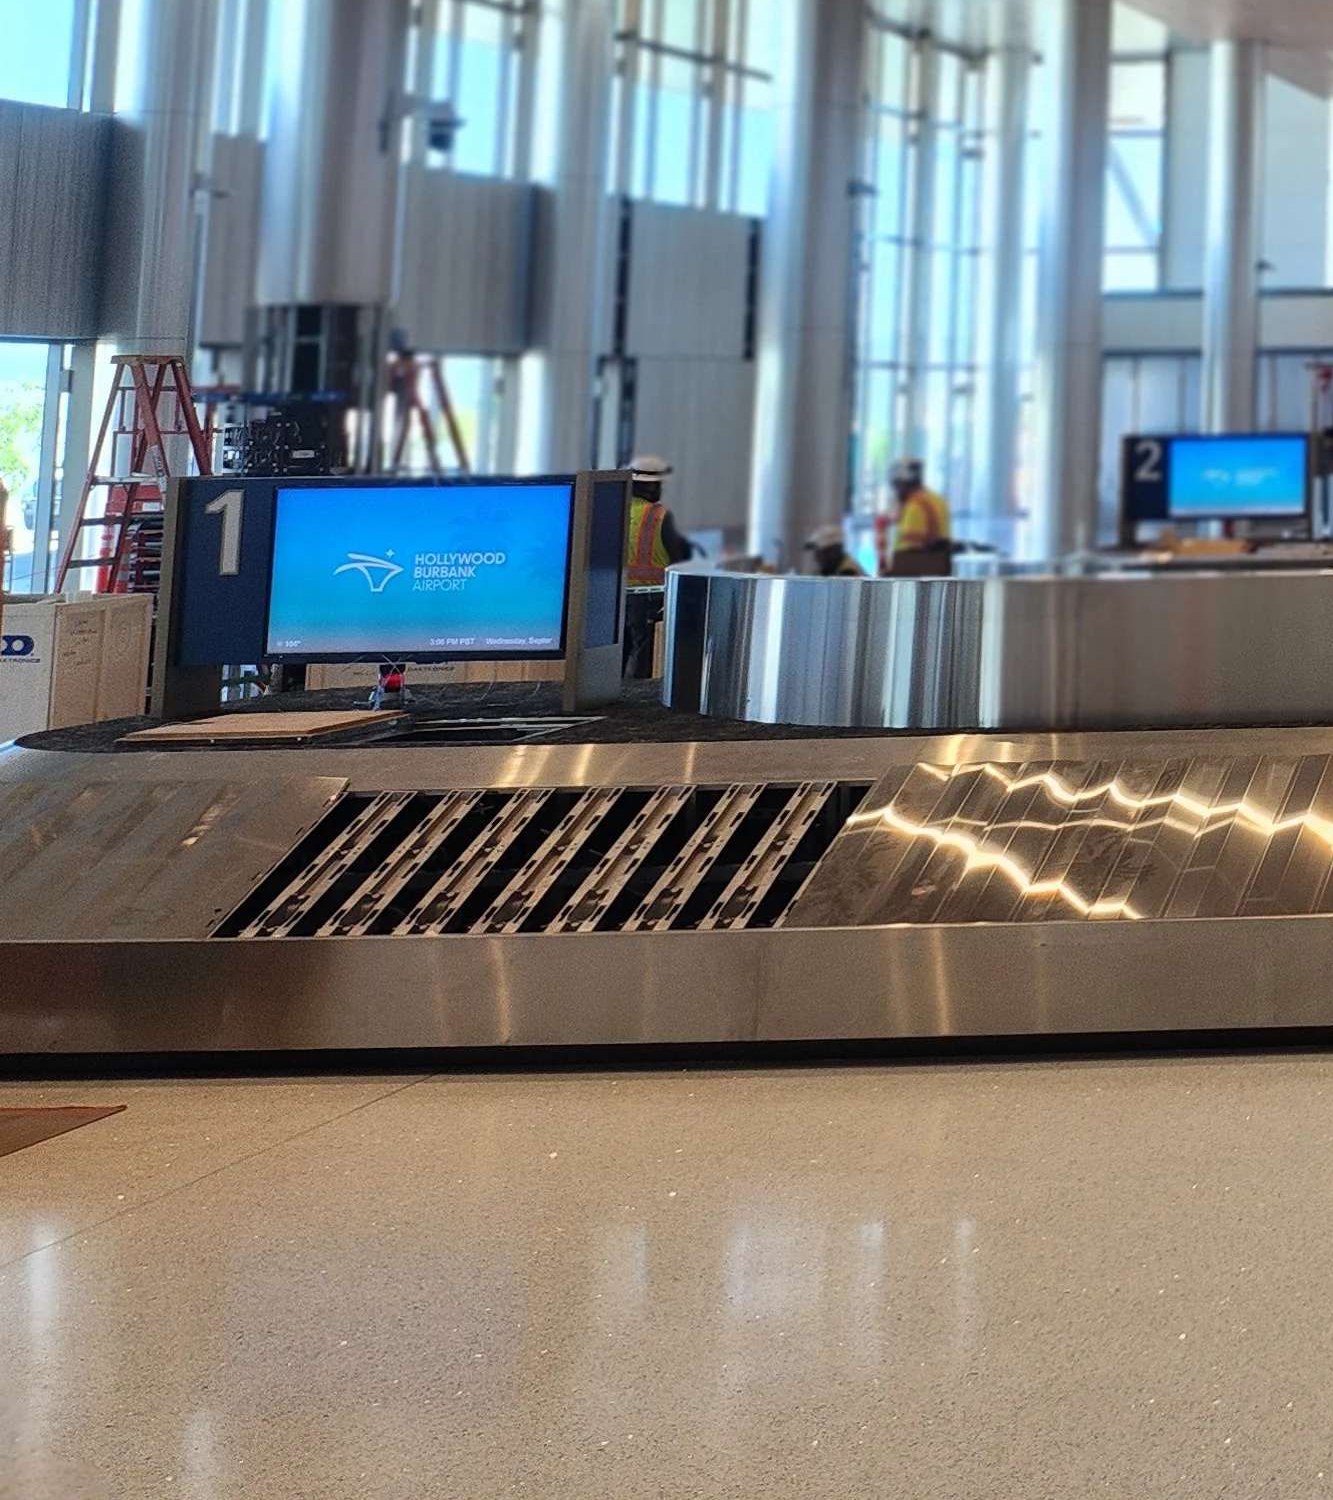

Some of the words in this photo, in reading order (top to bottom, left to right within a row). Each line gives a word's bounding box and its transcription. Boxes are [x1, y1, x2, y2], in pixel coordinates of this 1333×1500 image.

[1134, 439, 1163, 482] 2
[204, 489, 245, 576] 1
[415, 552, 505, 565] HOLLYWOOD
[414, 566, 476, 578] BURBANK
[412, 579, 469, 591] AIRPORT
